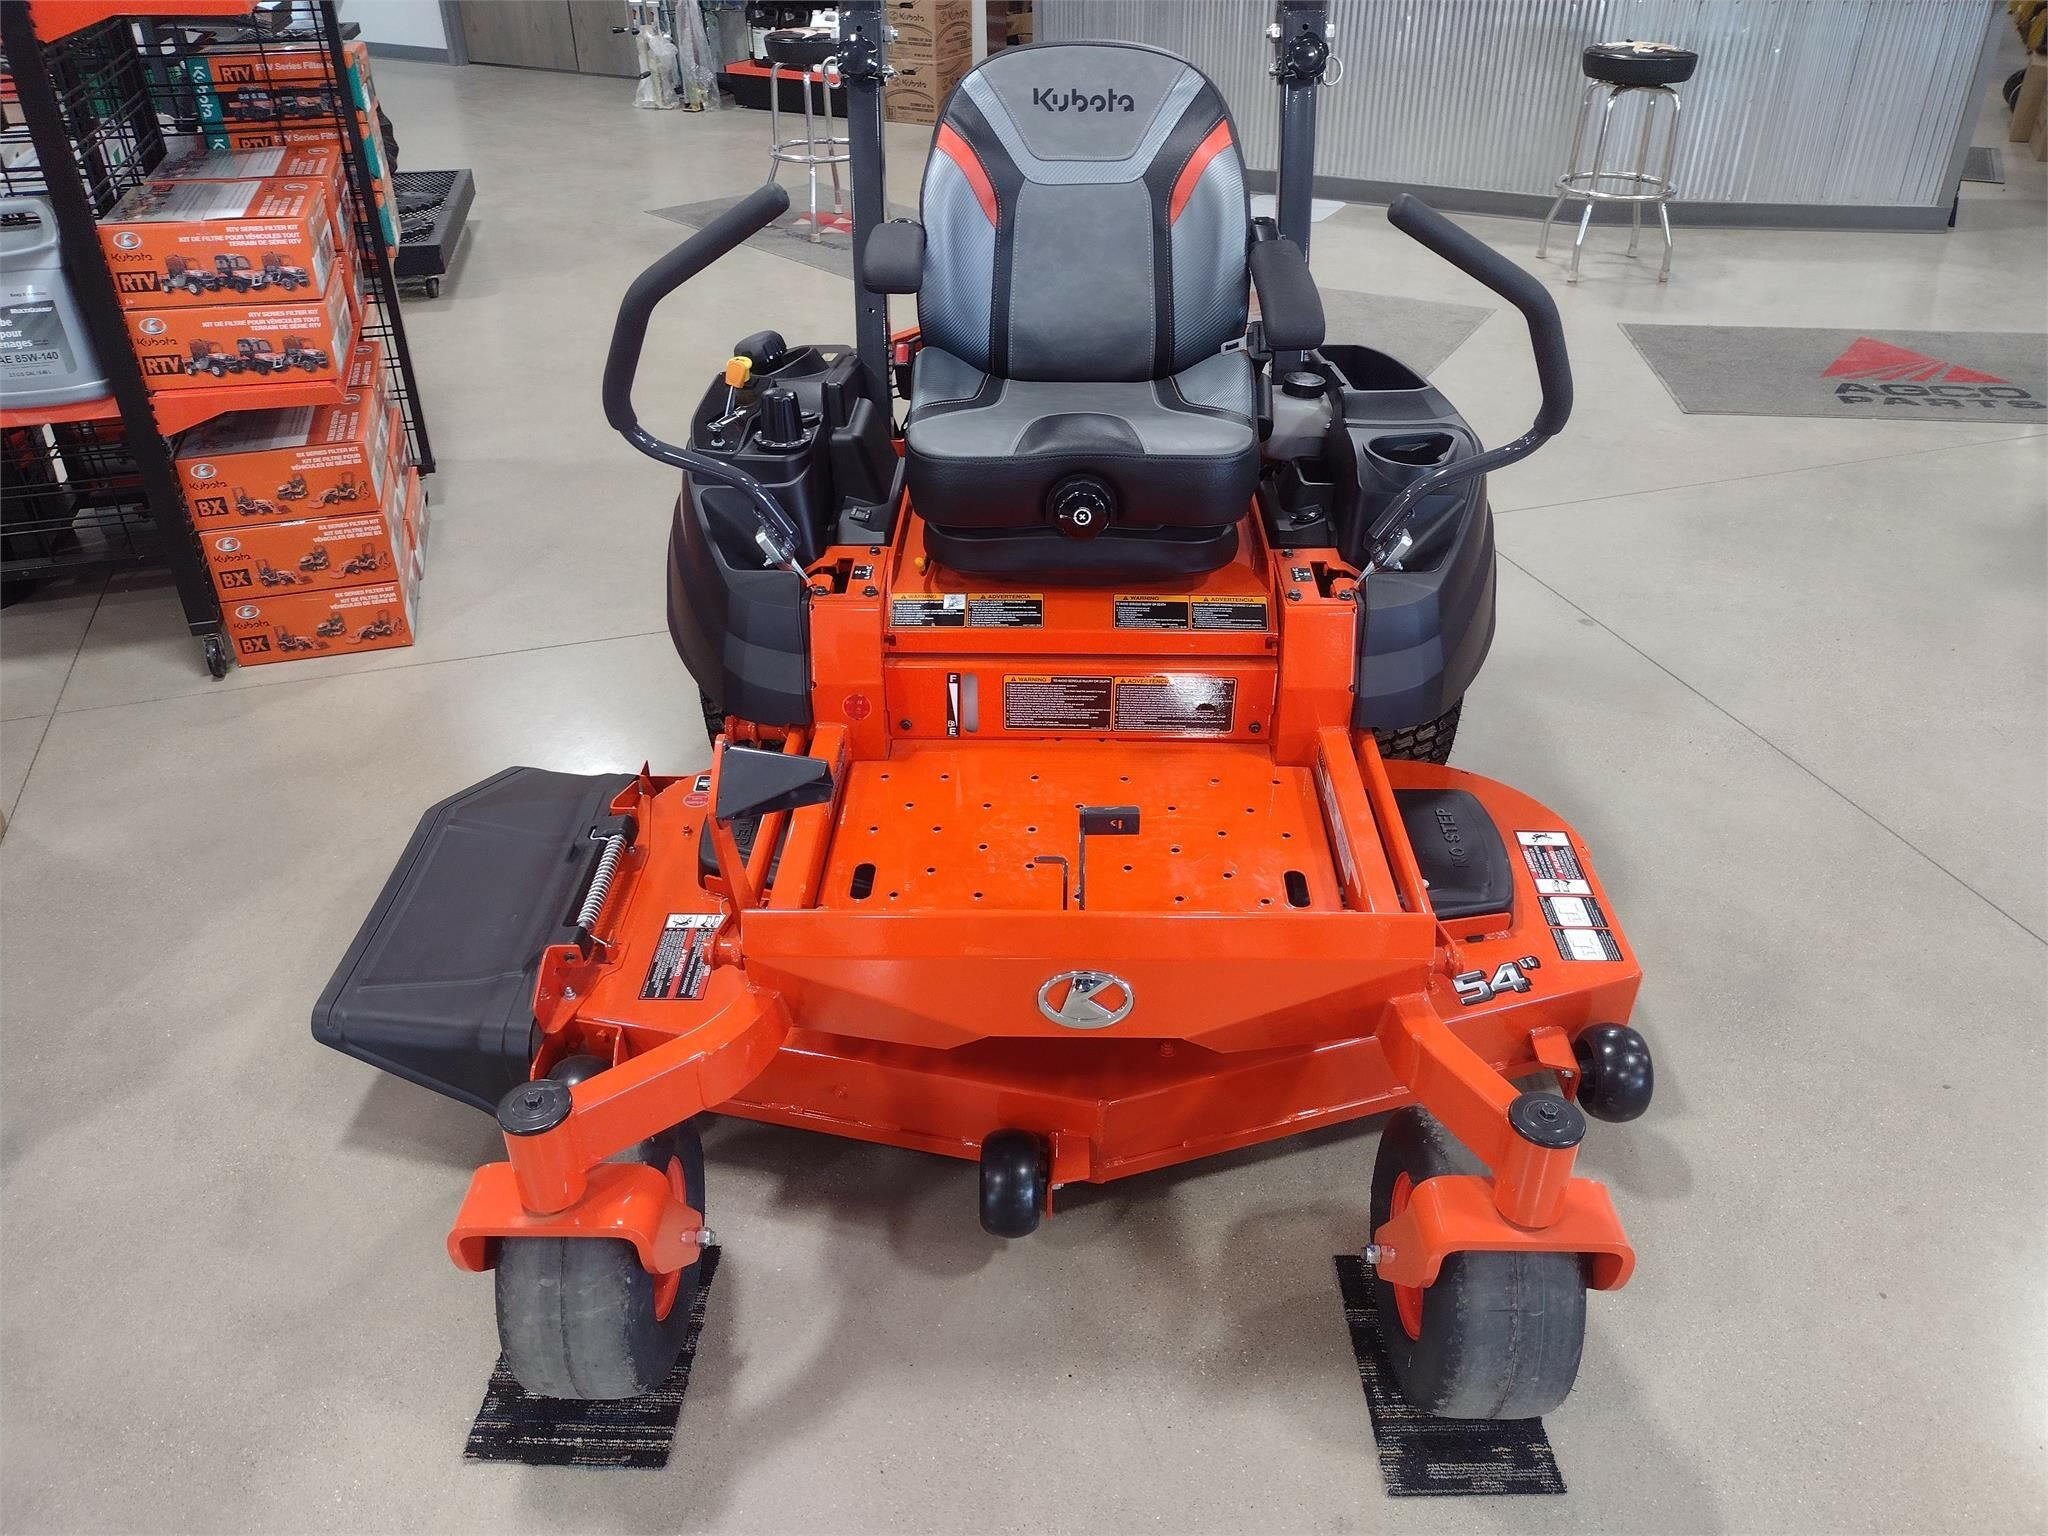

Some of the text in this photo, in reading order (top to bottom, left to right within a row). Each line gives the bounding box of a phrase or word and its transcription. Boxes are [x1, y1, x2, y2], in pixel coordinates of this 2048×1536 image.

[898, 12, 925, 22] Kubota
[221, 66, 252, 82] RTV
[901, 79, 927, 88] Kubota
[1033, 88, 1135, 112] Kubota
[225, 233, 245, 241] POUR
[281, 231, 300, 239] TOUT
[288, 237, 302, 245] RTV
[111, 252, 153, 262] Kubota
[120, 273, 156, 291] RTV
[302, 316, 320, 324] TOUT
[0, 330, 22, 341] pour
[137, 337, 178, 347] Kubota
[15, 351, 59, 364] 85W-140
[145, 357, 181, 374] RTV
[1835, 382, 2032, 399] AGCO
[1837, 395, 2047, 409] PARTS
[327, 448, 348, 456] FILTER
[189, 481, 227, 491] Kubota
[198, 499, 226, 515] BX
[213, 553, 252, 563] Kubota
[223, 571, 250, 587] BX
[233, 620, 271, 630] Kubota
[241, 637, 268, 653] BX
[949, 675, 957, 683] F
[949, 727, 957, 735] E
[1435, 808, 1471, 868] NO STEP
[674, 954, 687, 977] PELIGRO
[1452, 956, 1541, 1006] 54"
